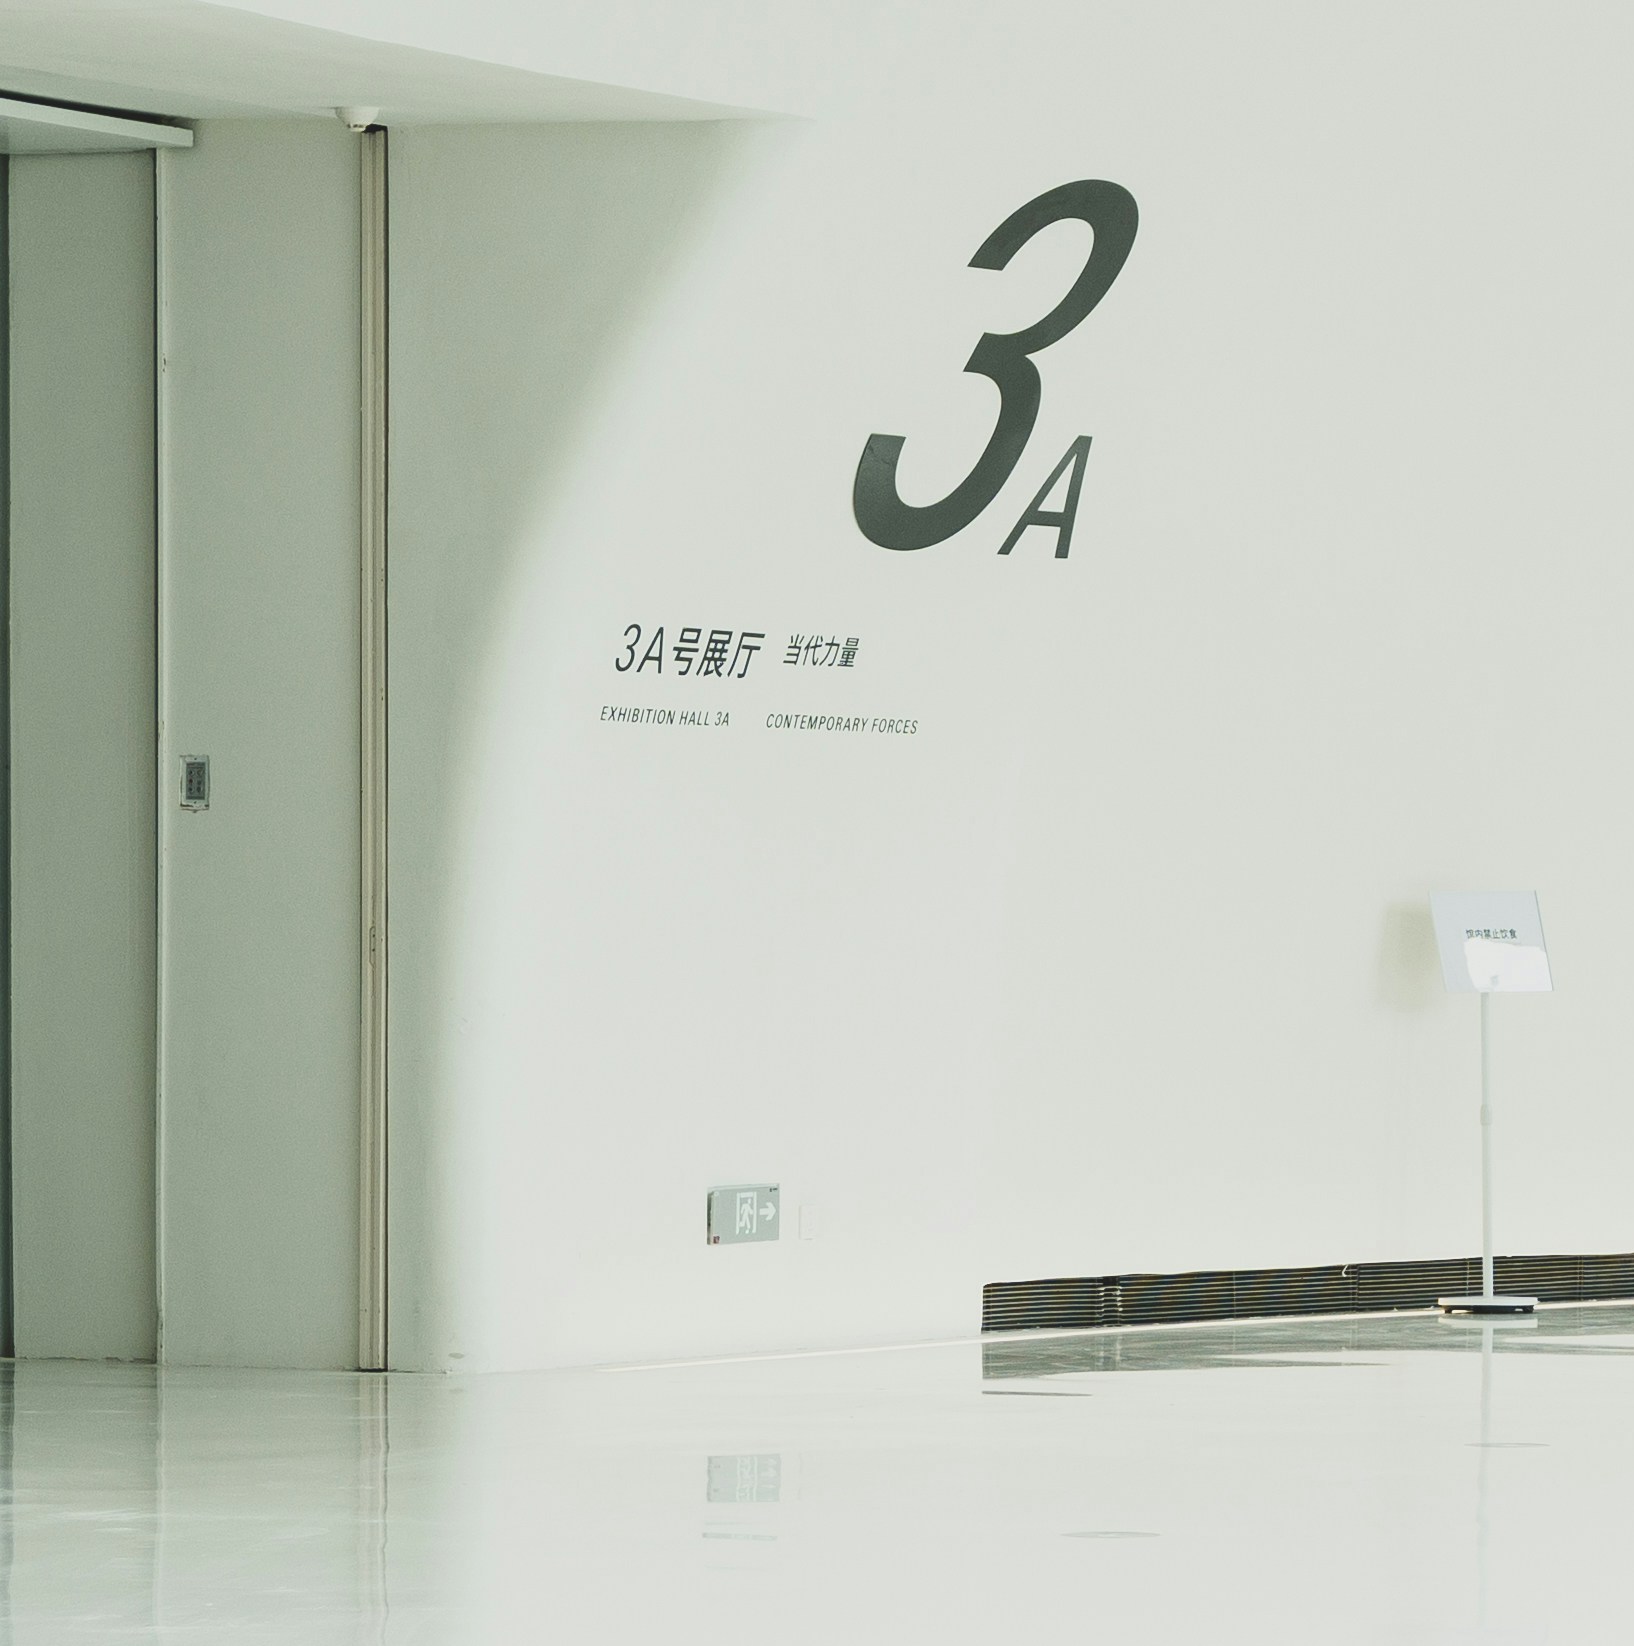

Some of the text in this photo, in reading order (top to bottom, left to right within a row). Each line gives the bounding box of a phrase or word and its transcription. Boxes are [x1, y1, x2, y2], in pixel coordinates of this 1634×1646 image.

[853, 178, 1140, 559] 3A
[614, 622, 860, 679] 3A号展厅 当代力量
[600, 705, 919, 735] EXHIBITION HALL 3A CONTEMPORARY FORCES
